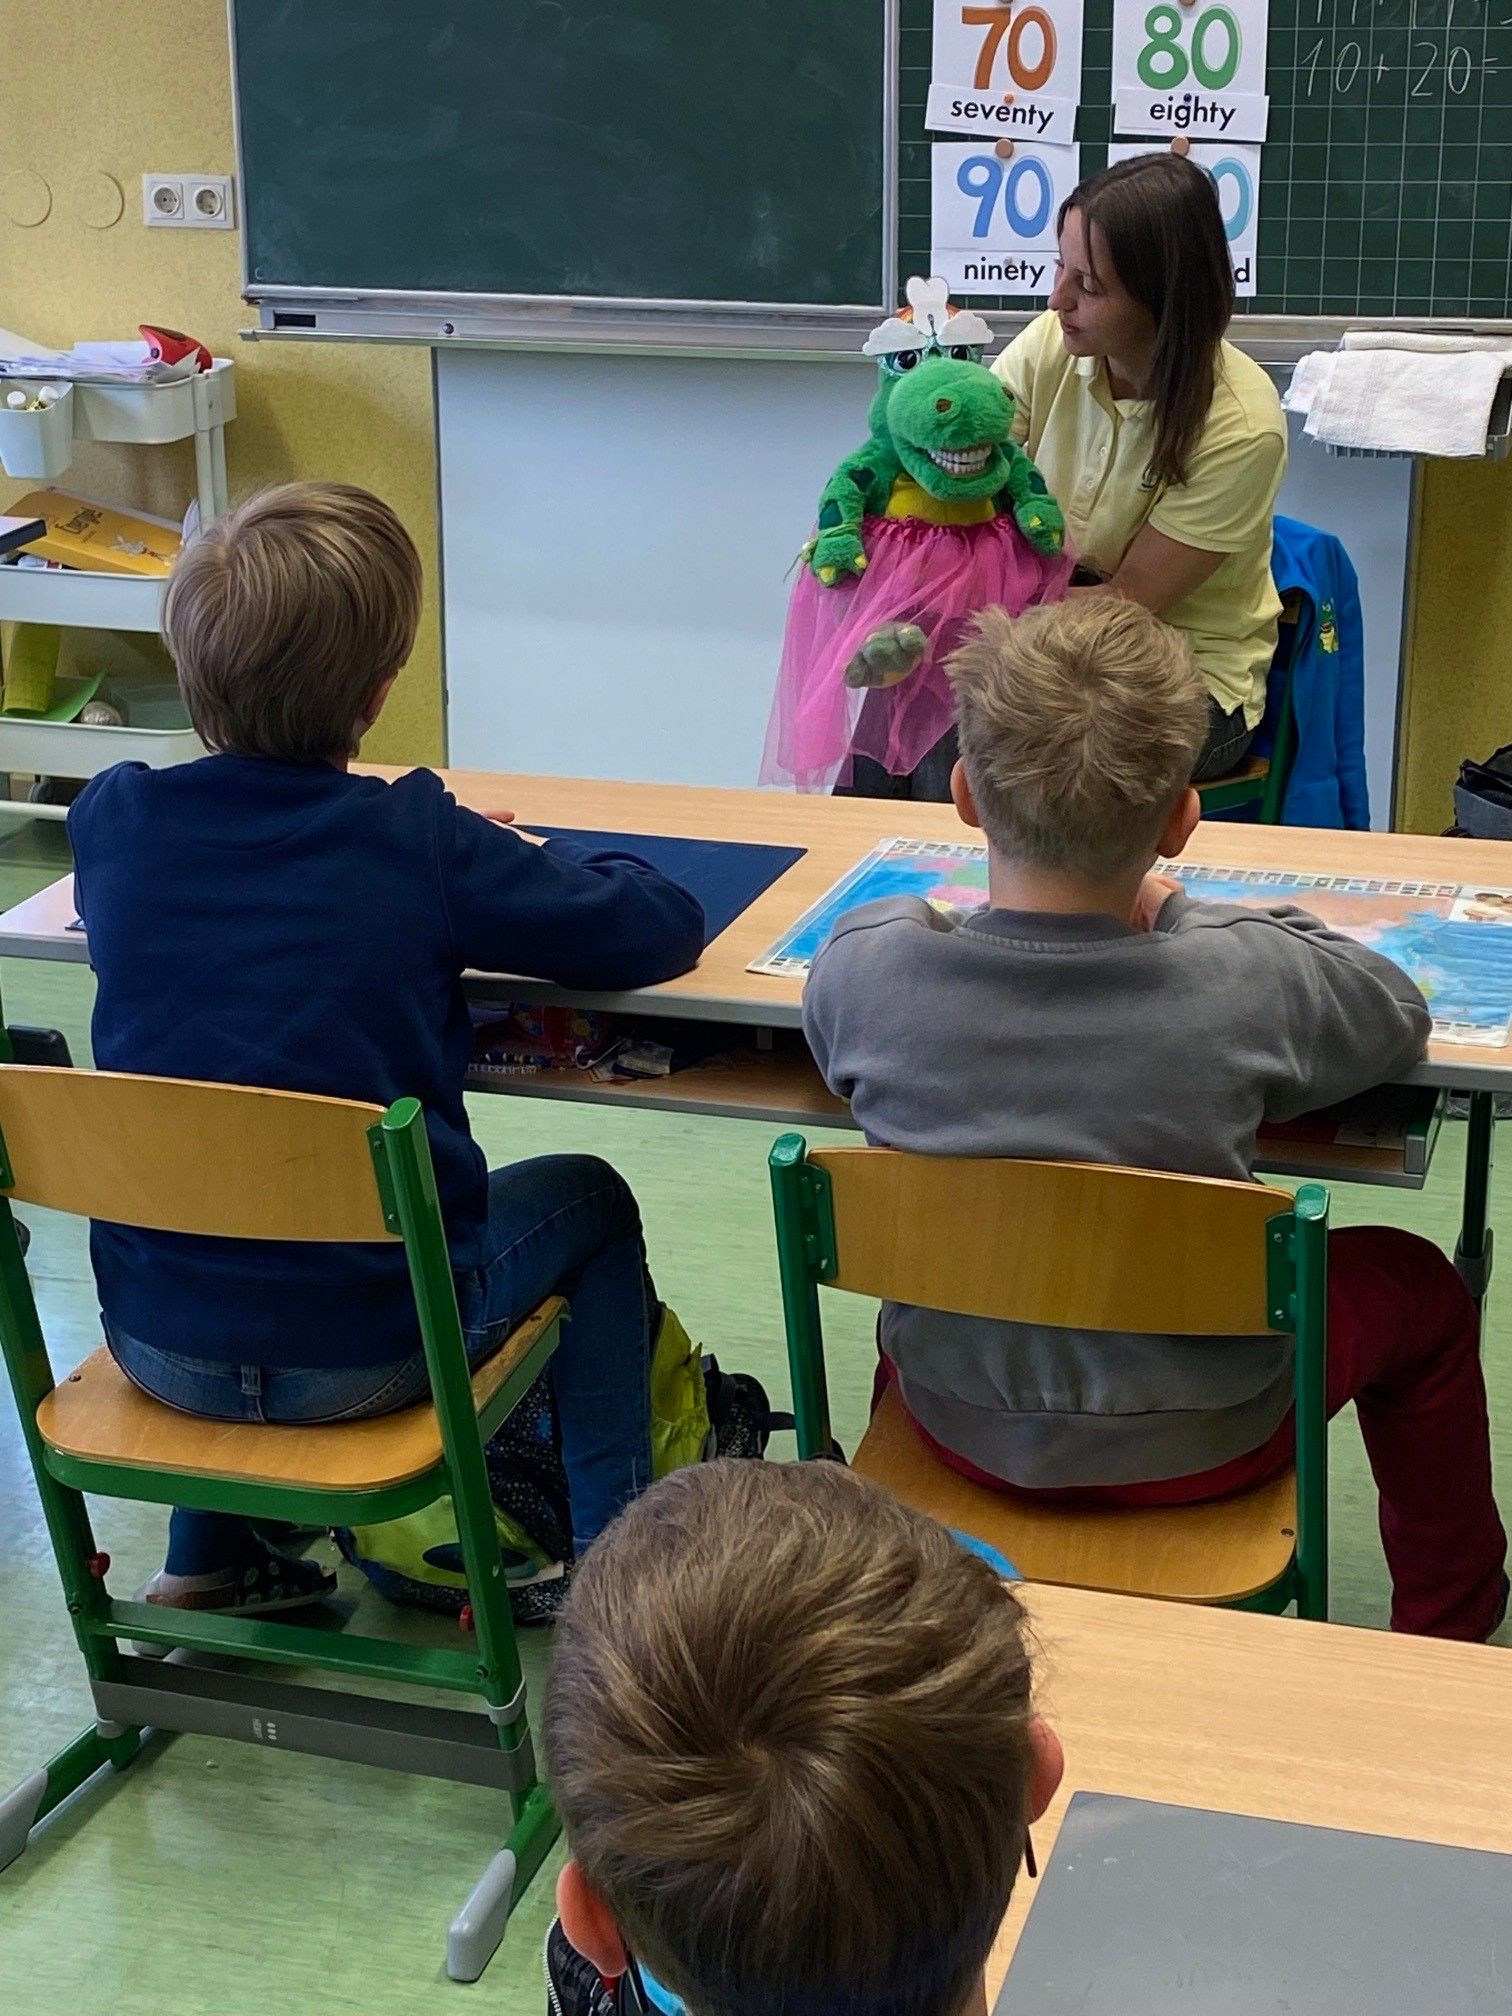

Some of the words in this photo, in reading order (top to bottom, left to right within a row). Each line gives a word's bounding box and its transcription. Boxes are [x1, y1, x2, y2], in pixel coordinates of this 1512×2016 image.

[962, 5, 1058, 91] 70
[1137, 3, 1243, 90] 80
[950, 100, 1055, 134] seventy
[1149, 95, 1237, 131] eighty
[956, 154, 1055, 238] 90
[963, 256, 1046, 288] ninety
